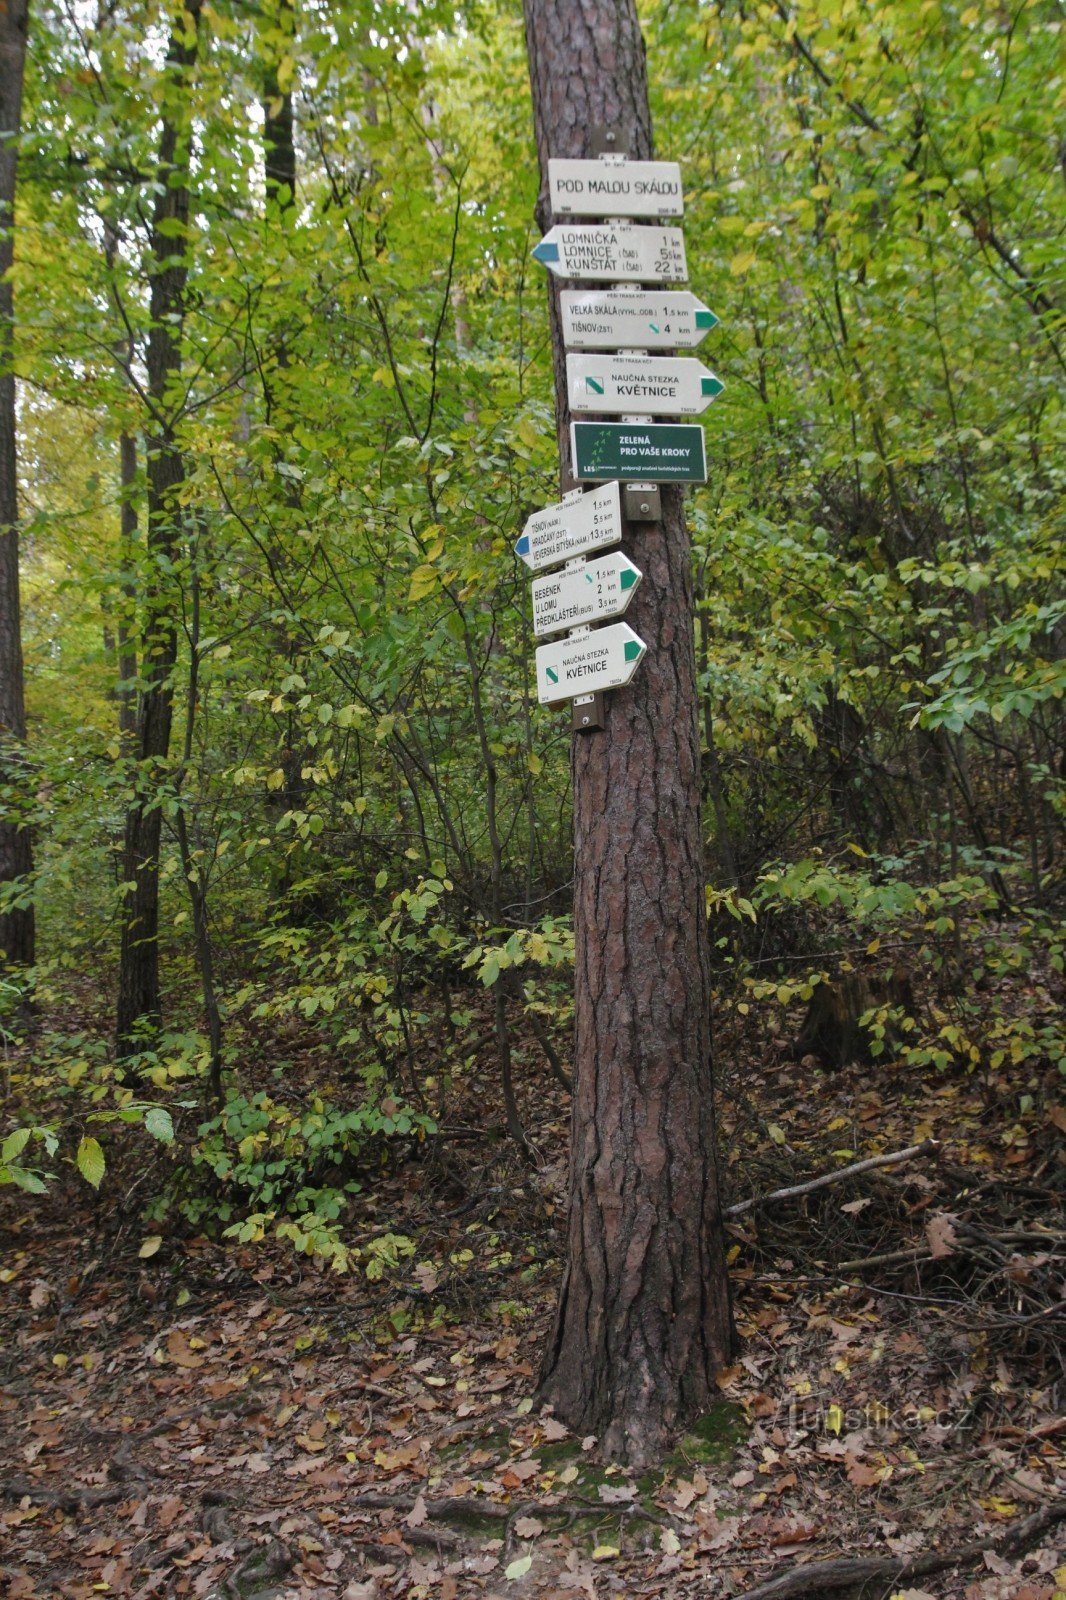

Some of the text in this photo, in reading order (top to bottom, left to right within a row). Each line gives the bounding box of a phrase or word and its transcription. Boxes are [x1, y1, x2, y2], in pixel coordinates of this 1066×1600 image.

[556, 178, 678, 194] POD MALOU SKÁLOU
[562, 232, 680, 246] LOMNIČKA 1 km
[564, 246, 612, 258] LOMNICE
[566, 256, 617, 272] KUNŠTÁT
[654, 260, 670, 273] 22
[674, 263, 684, 273] km
[570, 304, 592, 315] VELKÁ
[664, 324, 670, 334] 4
[612, 373, 680, 384] NAUČNÁ STEZKA
[617, 384, 676, 397] KVĚTNICE
[620, 435, 650, 445] ZELENÁ
[620, 446, 690, 456] PRO VAŠE KROKY
[603, 499, 612, 507] km
[604, 513, 612, 521] km
[536, 603, 540, 614] U
[541, 598, 557, 612] LOMU
[598, 584, 602, 594] 2
[562, 648, 609, 666] NAUČNÁ STEZKA
[566, 660, 607, 680] KVĚTNICE
